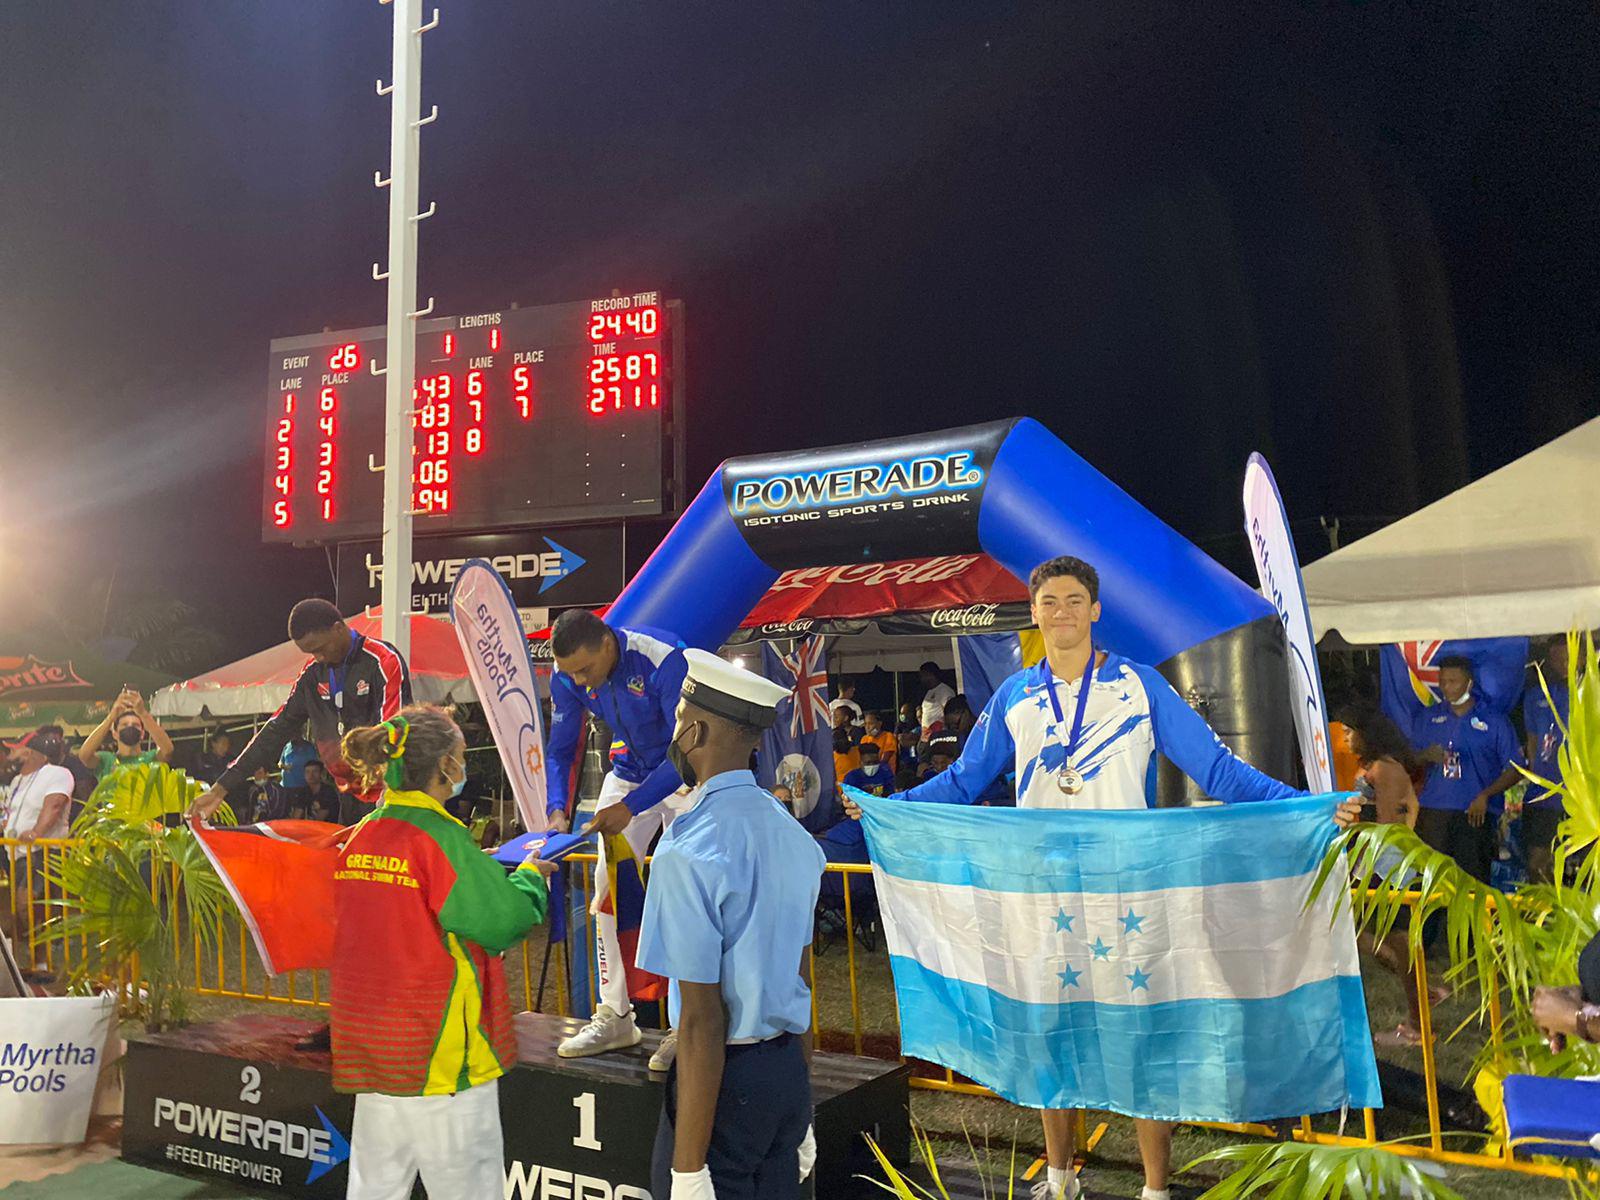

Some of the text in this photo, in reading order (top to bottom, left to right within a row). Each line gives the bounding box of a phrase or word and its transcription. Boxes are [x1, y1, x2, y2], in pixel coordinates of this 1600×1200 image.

[591, 294, 657, 312] RECORD TIME
[459, 312, 501, 329] LENGTHS
[330, 345, 357, 369] 26
[513, 351, 544, 365] PLACE
[593, 342, 616, 356] TIME
[283, 355, 309, 370] EVENT
[469, 355, 493, 370] LANE
[280, 377, 302, 390] LANE
[321, 372, 349, 386] PLACE
[468, 372, 482, 396] 6
[514, 367, 529, 391] 5
[285, 394, 293, 414] 1
[320, 388, 334, 411] 6
[516, 396, 529, 418] 7
[469, 401, 482, 422] 7
[277, 419, 291, 442] 2
[320, 416, 334, 436] 4
[466, 429, 481, 452] 8
[277, 446, 290, 470] 3
[319, 442, 332, 466] 3
[275, 475, 289, 494] 4
[317, 470, 331, 493] 2
[735, 453, 971, 513] POWERADE
[275, 501, 287, 525] 5
[323, 499, 330, 519] 1
[744, 493, 970, 527] ISOTONIC SPORTS DRINK
[930, 603, 1000, 628] Coca-Cola
[346, 854, 409, 874] GRENADA
[1, 1042, 96, 1072] Myrtha
[0, 1068, 66, 1093] Pools
[240, 1065, 261, 1105] 2
[154, 1097, 333, 1165] POWERADE
[572, 1092, 602, 1151] 1
[165, 1143, 283, 1186] #FEELTHEPOWER
